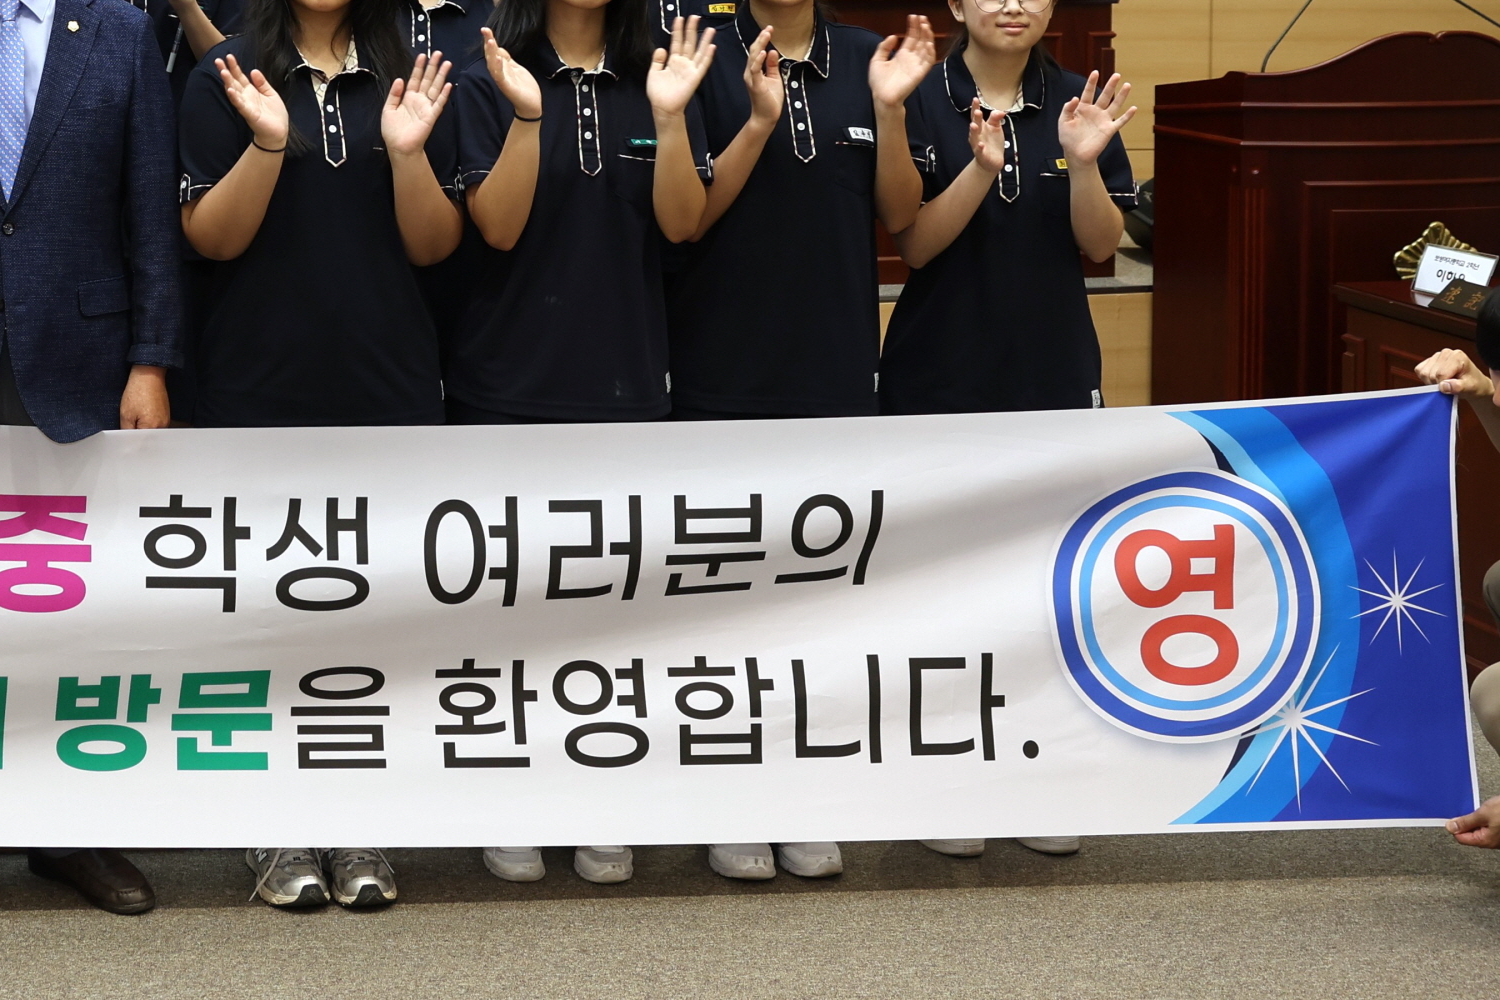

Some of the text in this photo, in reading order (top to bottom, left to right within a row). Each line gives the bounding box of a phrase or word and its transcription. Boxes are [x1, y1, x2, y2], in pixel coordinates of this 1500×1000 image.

[138, 494, 370, 612] 학생
[423, 490, 884, 607] 여러분의
[1117, 525, 1239, 686] 영
[55, 665, 390, 772] 방문을
[434, 652, 1040, 768] 환영합니다.
